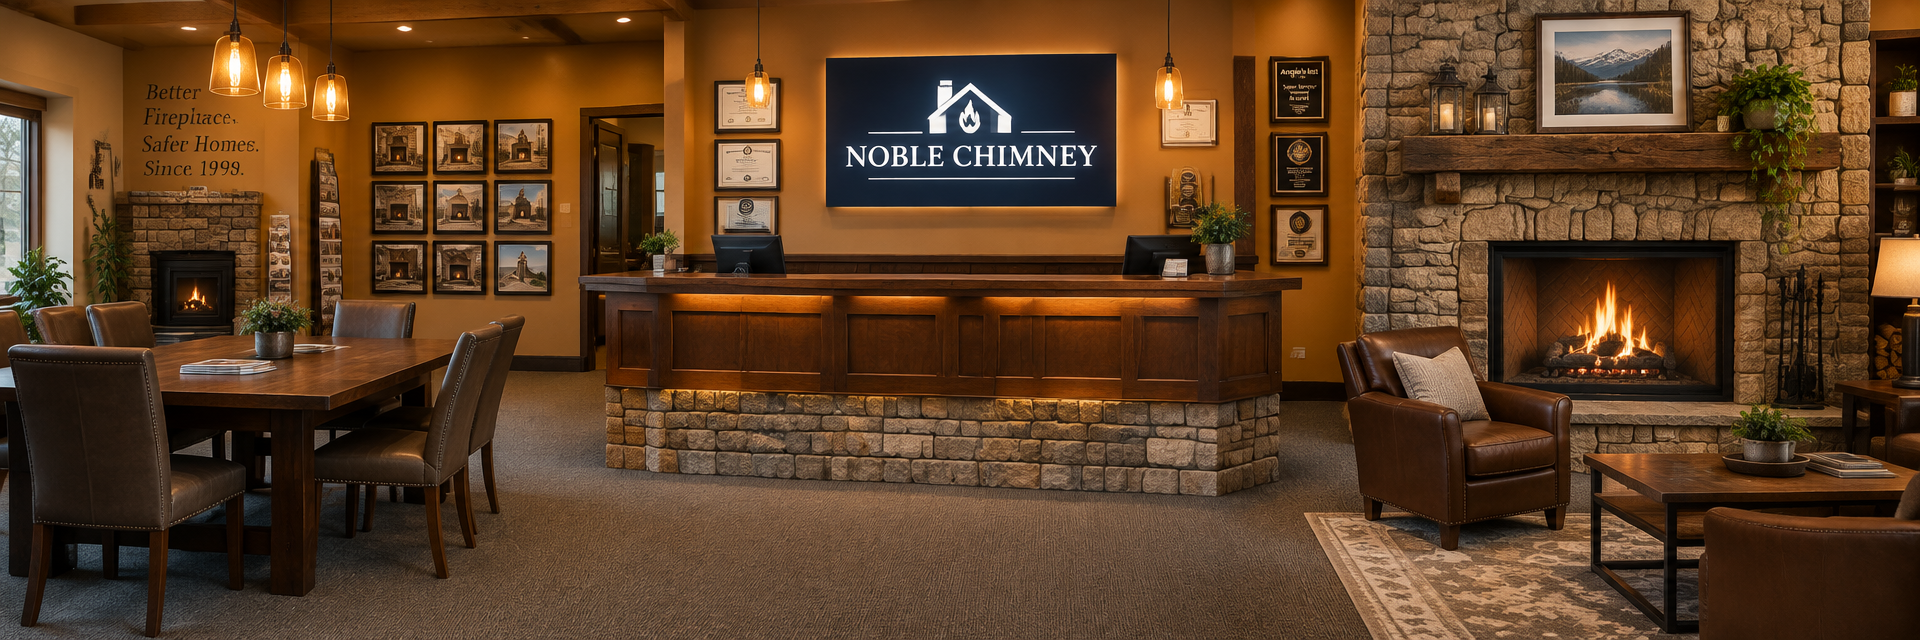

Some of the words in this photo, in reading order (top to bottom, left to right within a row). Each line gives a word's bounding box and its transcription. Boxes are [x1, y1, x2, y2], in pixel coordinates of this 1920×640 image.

[146, 84, 201, 100] Better
[142, 134, 189, 153] Safer
[194, 135, 259, 153] Homes.
[845, 144, 945, 168] NOBLE
[952, 144, 1098, 168] CHIMNEY
[143, 159, 193, 177] Since
